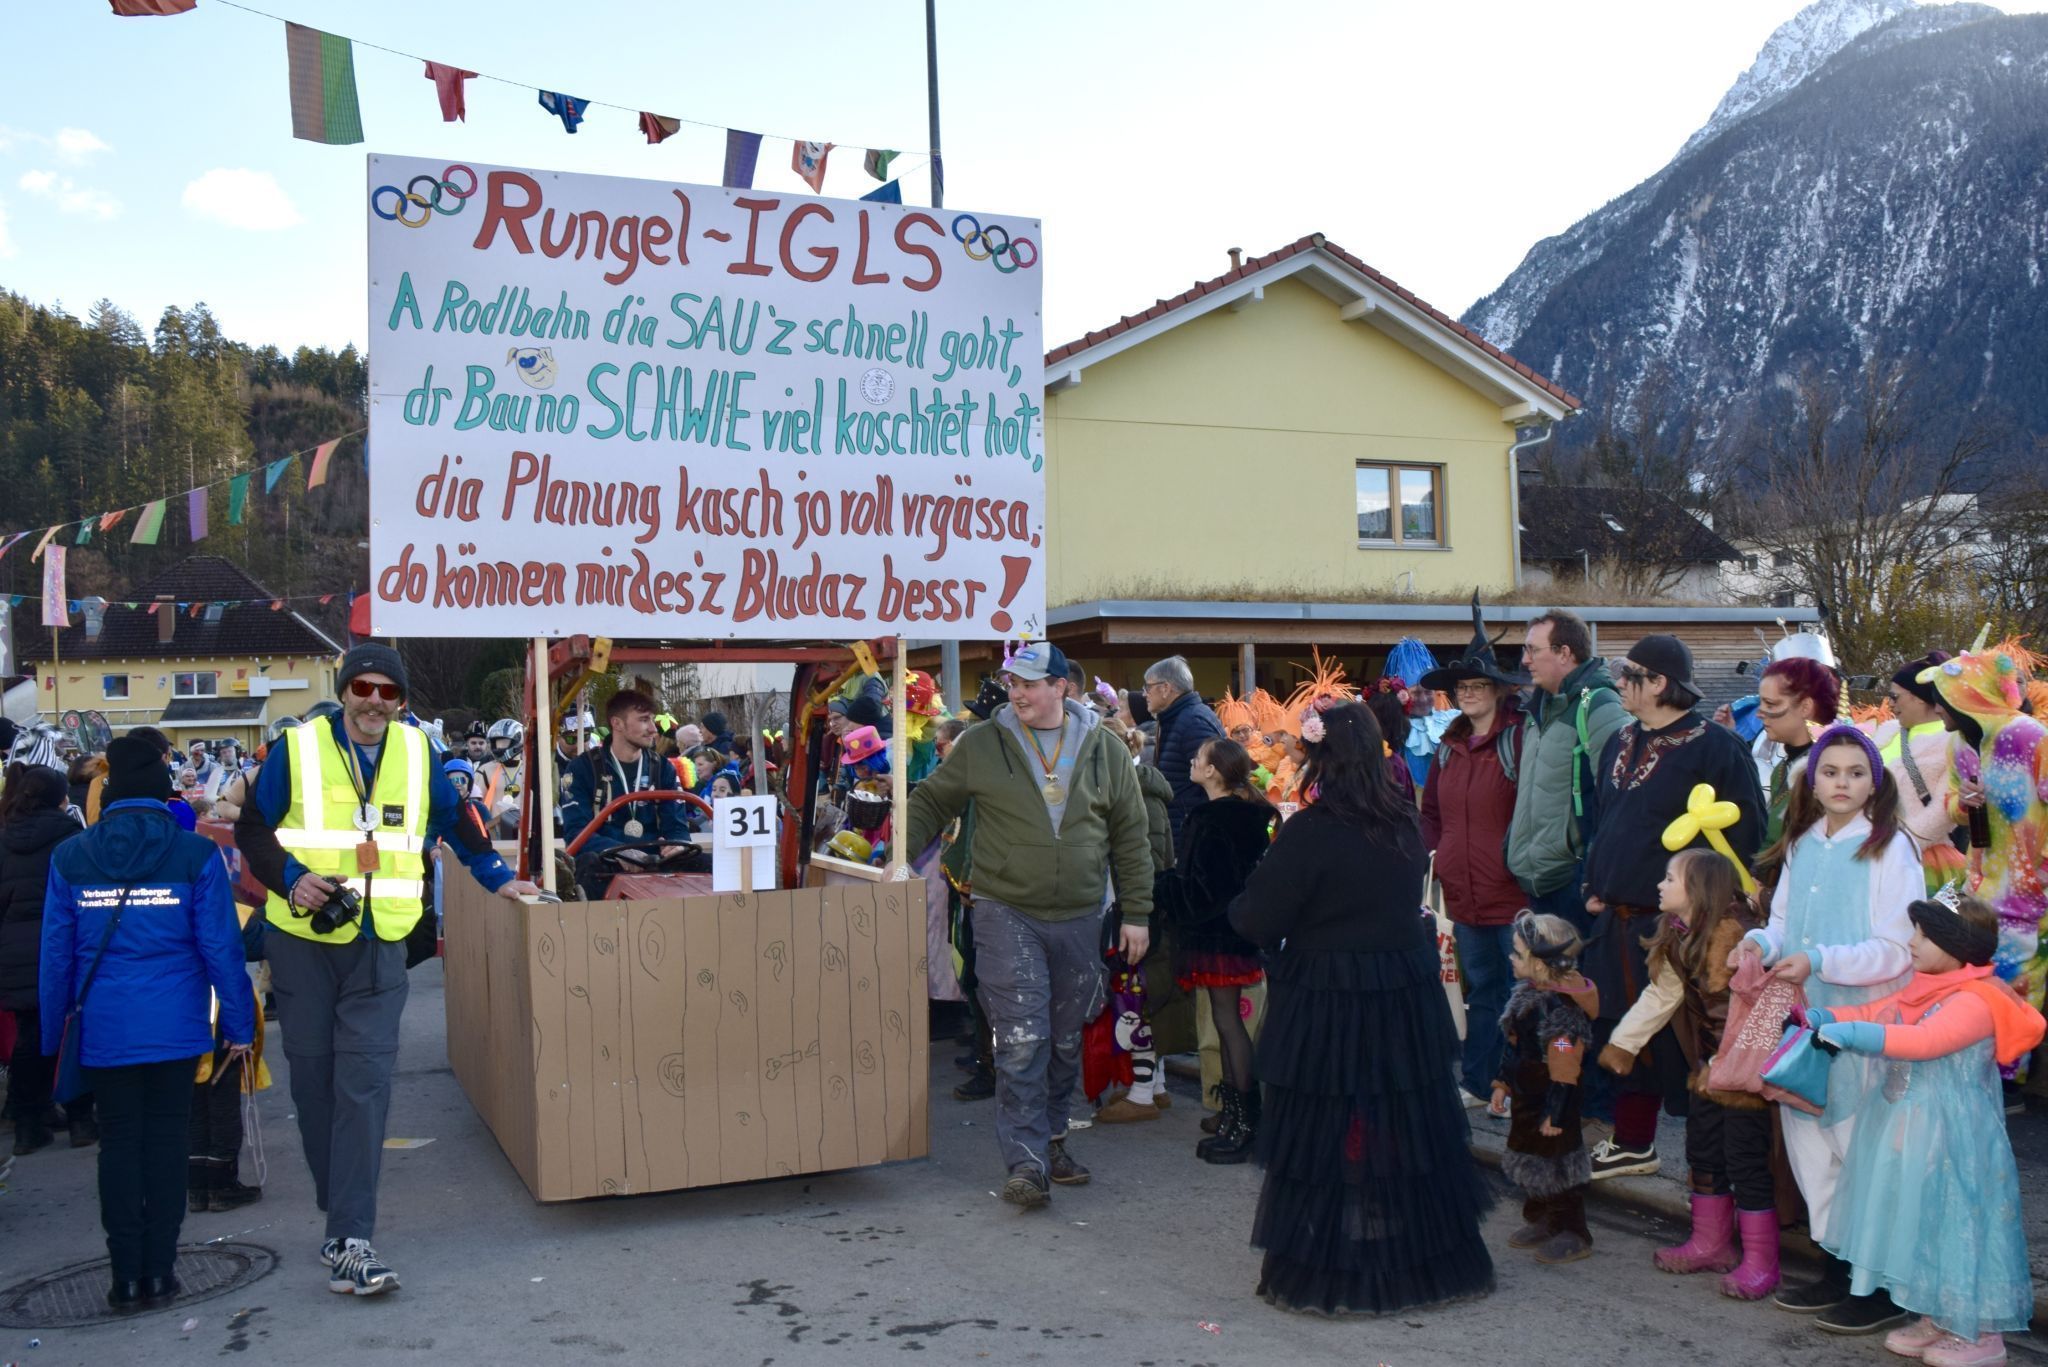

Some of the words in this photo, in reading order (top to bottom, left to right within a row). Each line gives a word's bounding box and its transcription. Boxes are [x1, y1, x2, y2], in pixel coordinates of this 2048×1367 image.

[388, 271, 423, 331] A
[432, 280, 590, 340] Rodlbahn
[402, 364, 453, 427] dr
[586, 361, 757, 452] SCHWIE
[762, 376, 823, 456] viel
[834, 376, 979, 458] koschtet
[501, 450, 662, 544] Planung
[675, 465, 784, 539] kasch
[792, 460, 832, 551] jo
[377, 543, 429, 605] do
[432, 542, 566, 609] können
[732, 547, 867, 623] Bludaz
[729, 805, 771, 837] 31
[82, 888, 117, 899] Verband
[118, 887, 172, 898] Vrarlberger
